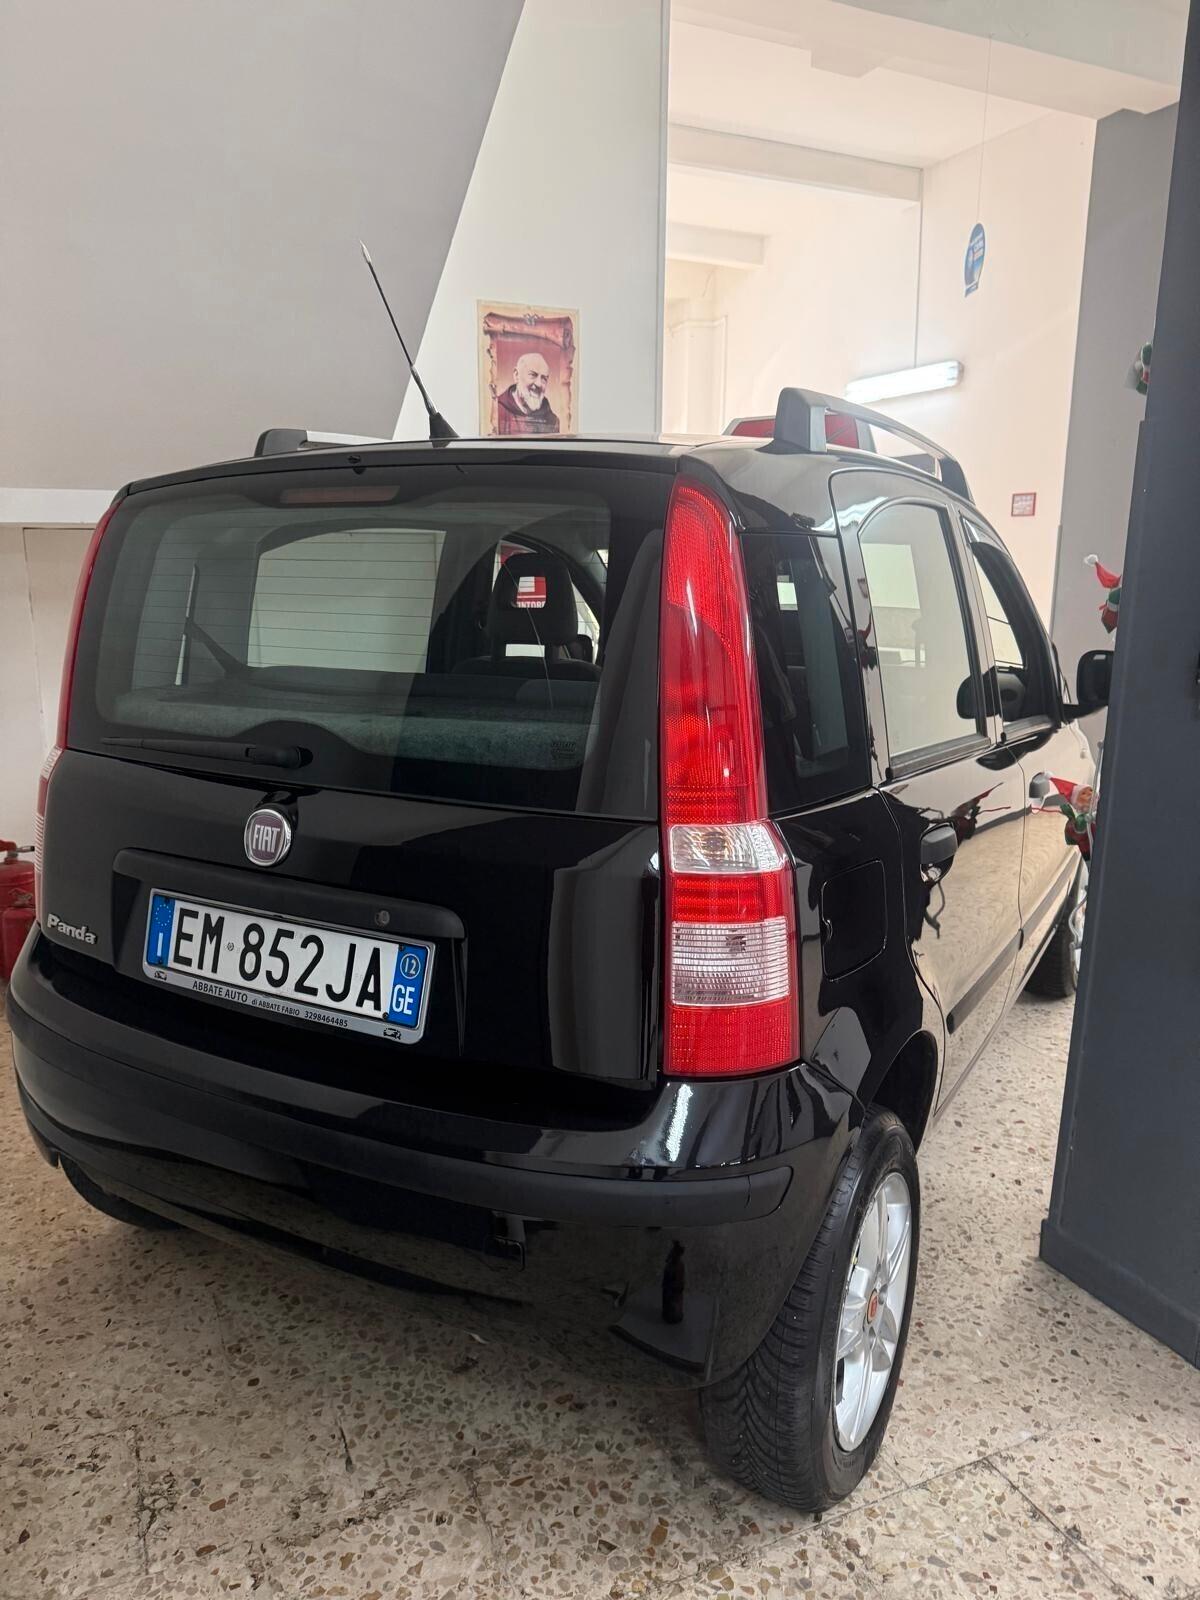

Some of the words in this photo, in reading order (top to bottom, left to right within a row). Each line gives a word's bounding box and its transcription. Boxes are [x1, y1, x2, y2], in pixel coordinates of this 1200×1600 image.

[252, 824, 280, 853] FIAT
[47, 913, 96, 945] Panda
[173, 907, 225, 974] EM
[238, 923, 382, 1012] 852JA
[403, 957, 417, 976] 12
[192, 980, 223, 997] ABBATE
[224, 988, 249, 1003] AUTO
[258, 1001, 281, 1012] ABBATE
[281, 1005, 301, 1016] FABIO
[304, 1010, 348, 1028] 3298464485
[392, 984, 415, 1015] GE
